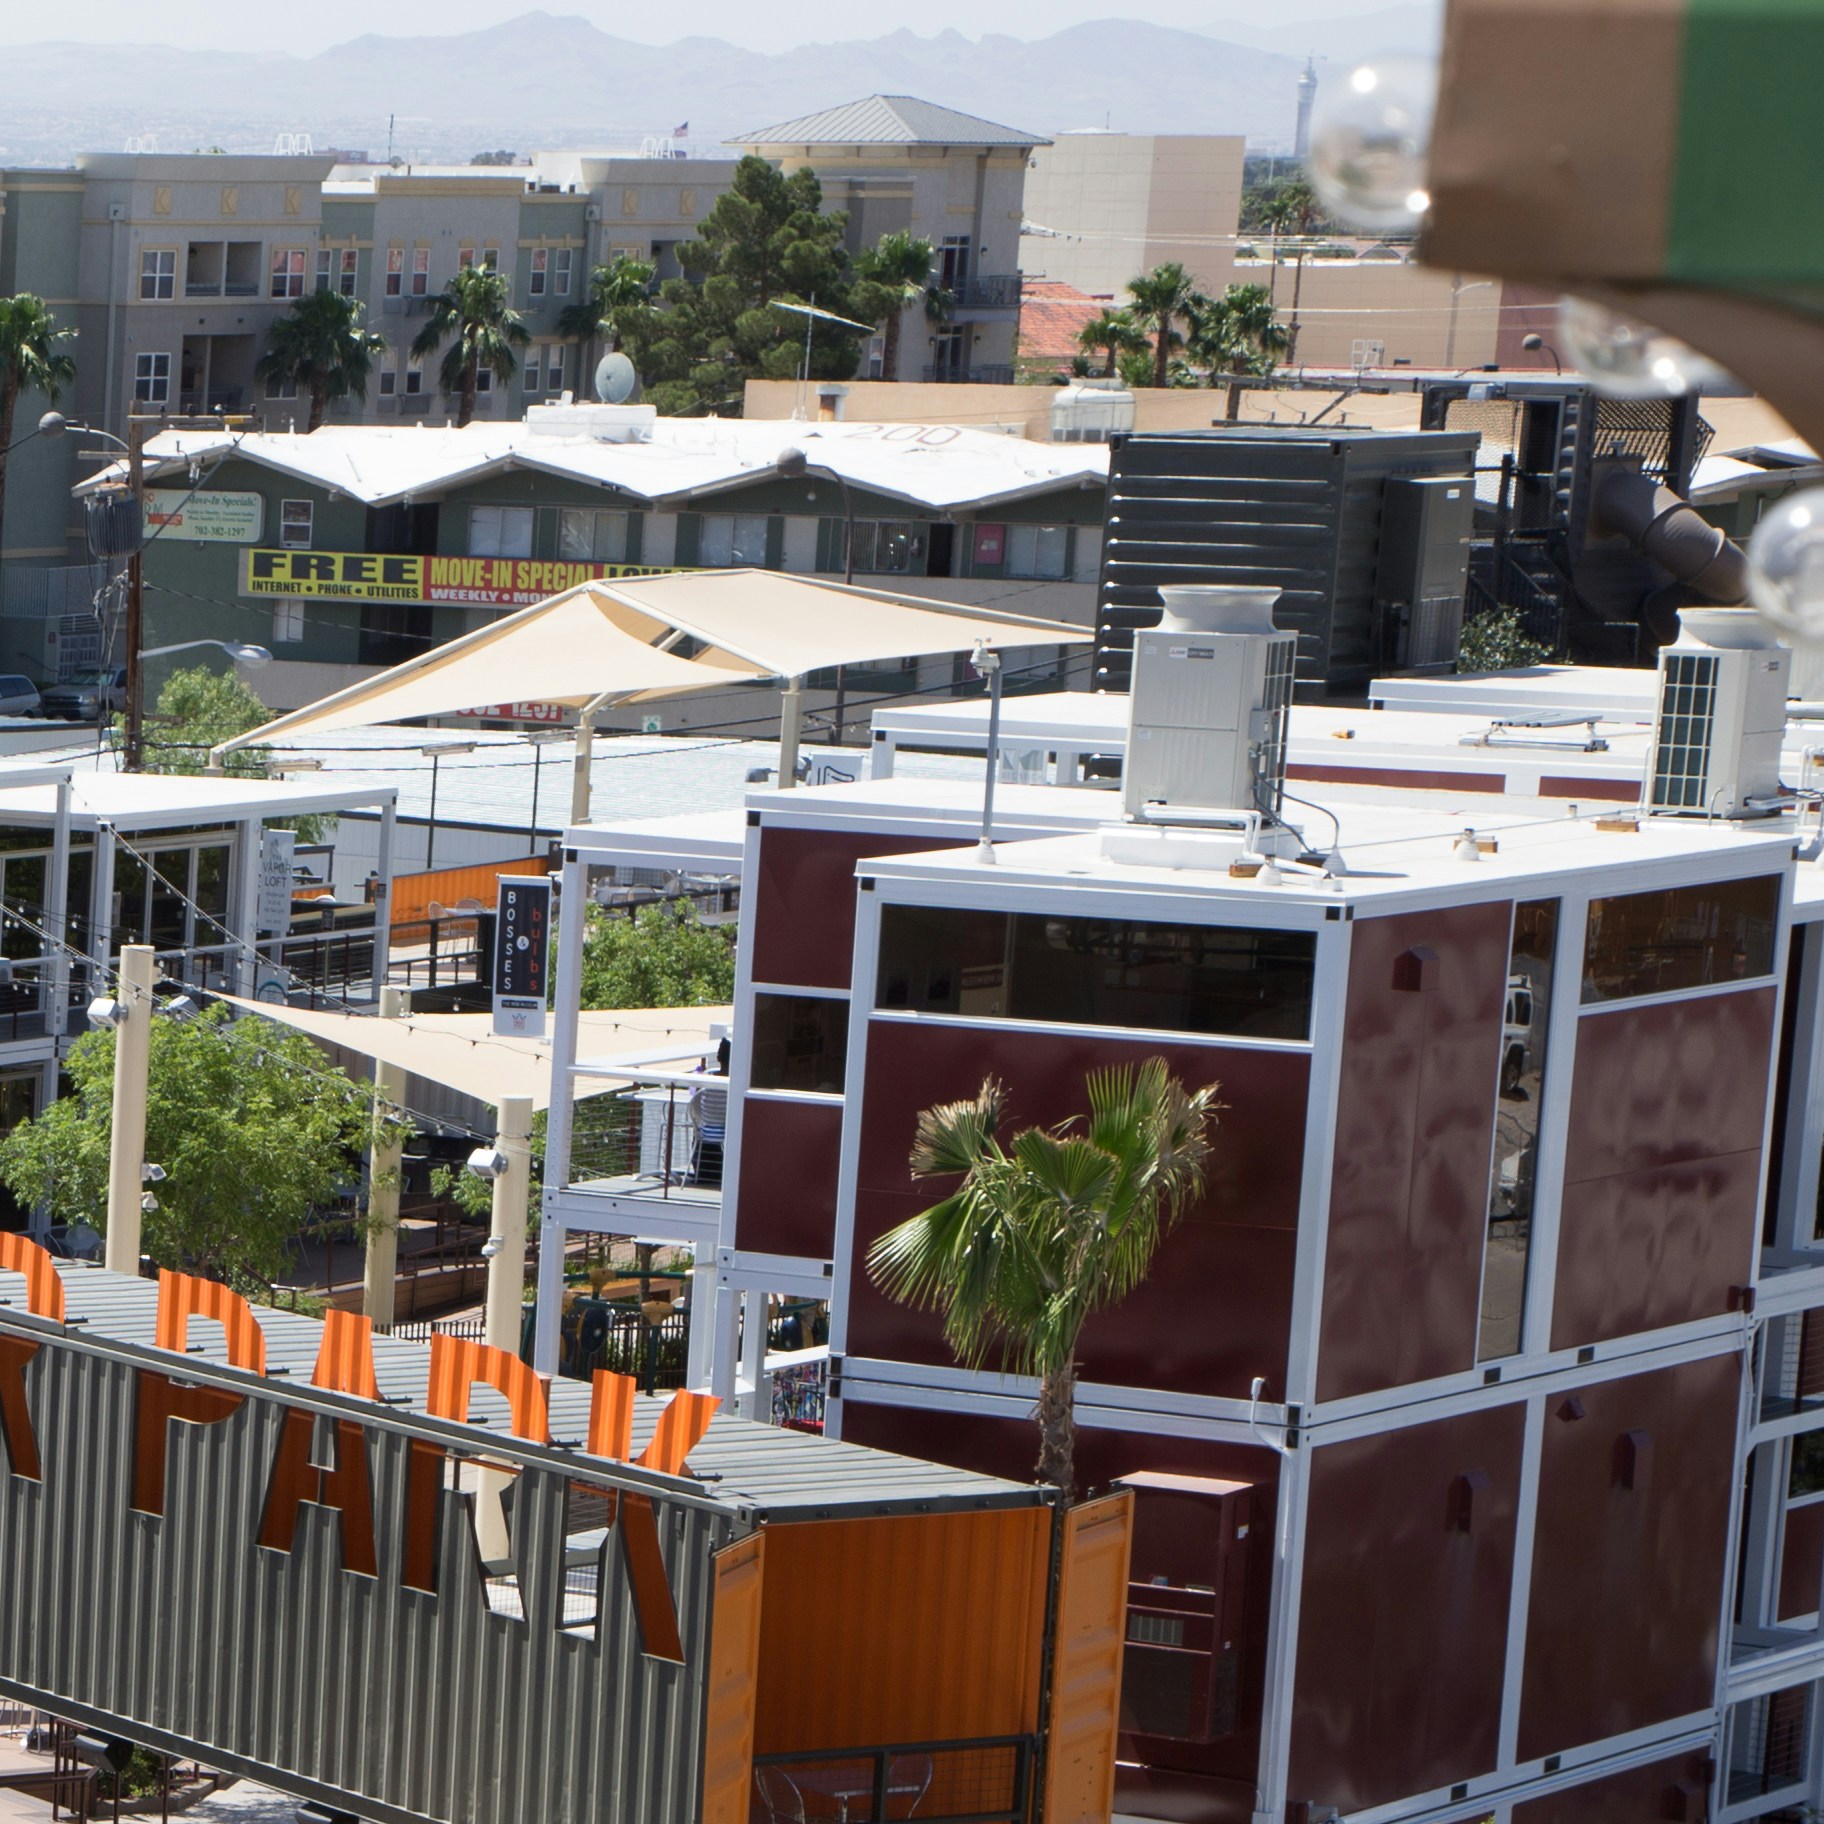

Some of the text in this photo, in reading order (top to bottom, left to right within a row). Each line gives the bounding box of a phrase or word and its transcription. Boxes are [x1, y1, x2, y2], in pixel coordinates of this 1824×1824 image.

[253, 551, 419, 585] FREE
[431, 557, 512, 588] MOVE-IN
[252, 580, 419, 599] INTERNET PHONE UTILITIES
[430, 588, 499, 602] WEEKLY
[264, 876, 287, 888] LOFT
[504, 891, 516, 990] BOSSES
[530, 907, 542, 990] bulbs
[129, 1268, 723, 1665] PARK
